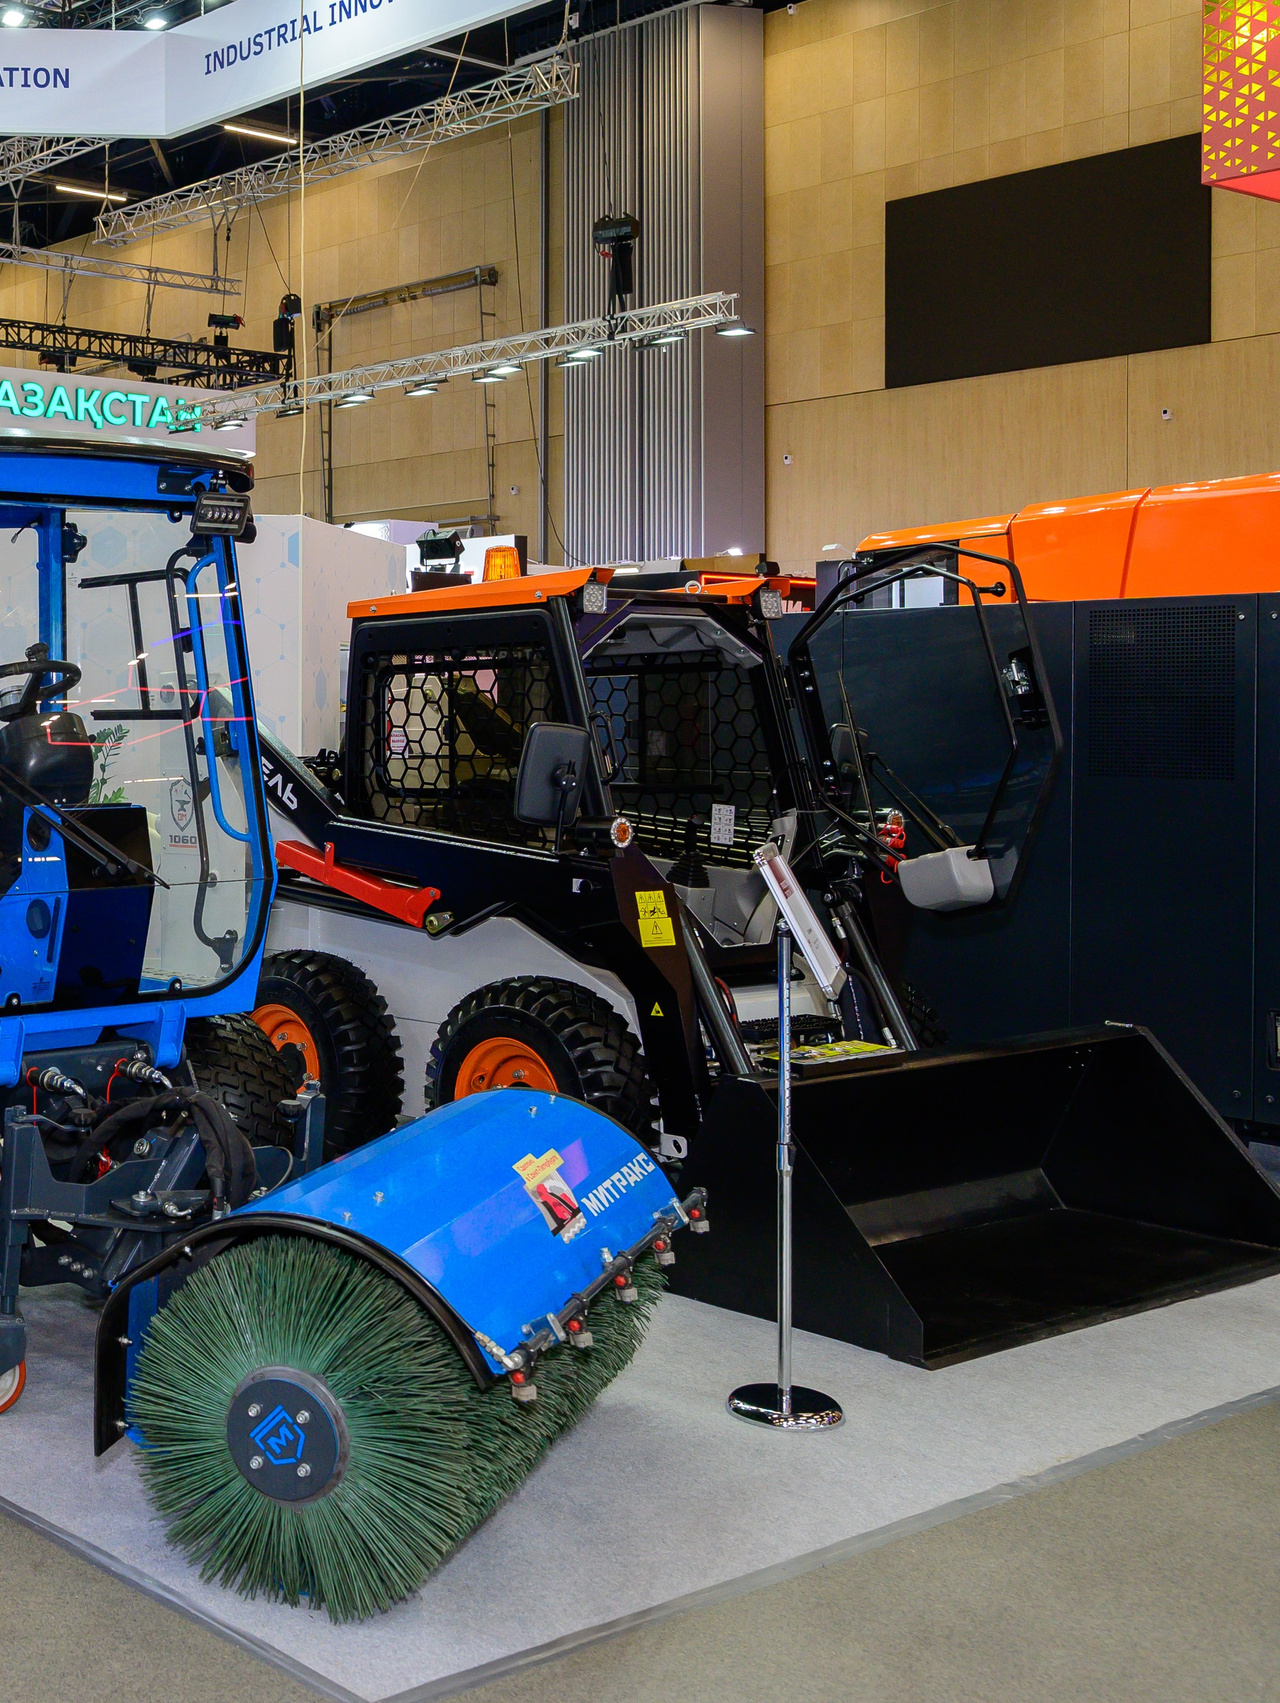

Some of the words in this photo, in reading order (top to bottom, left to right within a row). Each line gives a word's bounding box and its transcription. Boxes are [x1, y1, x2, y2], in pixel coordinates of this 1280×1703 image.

[204, 10, 323, 75] INDUSTRIAL
[168, 834, 198, 845] 1060
[580, 1152, 656, 1217] МИТРАКС
